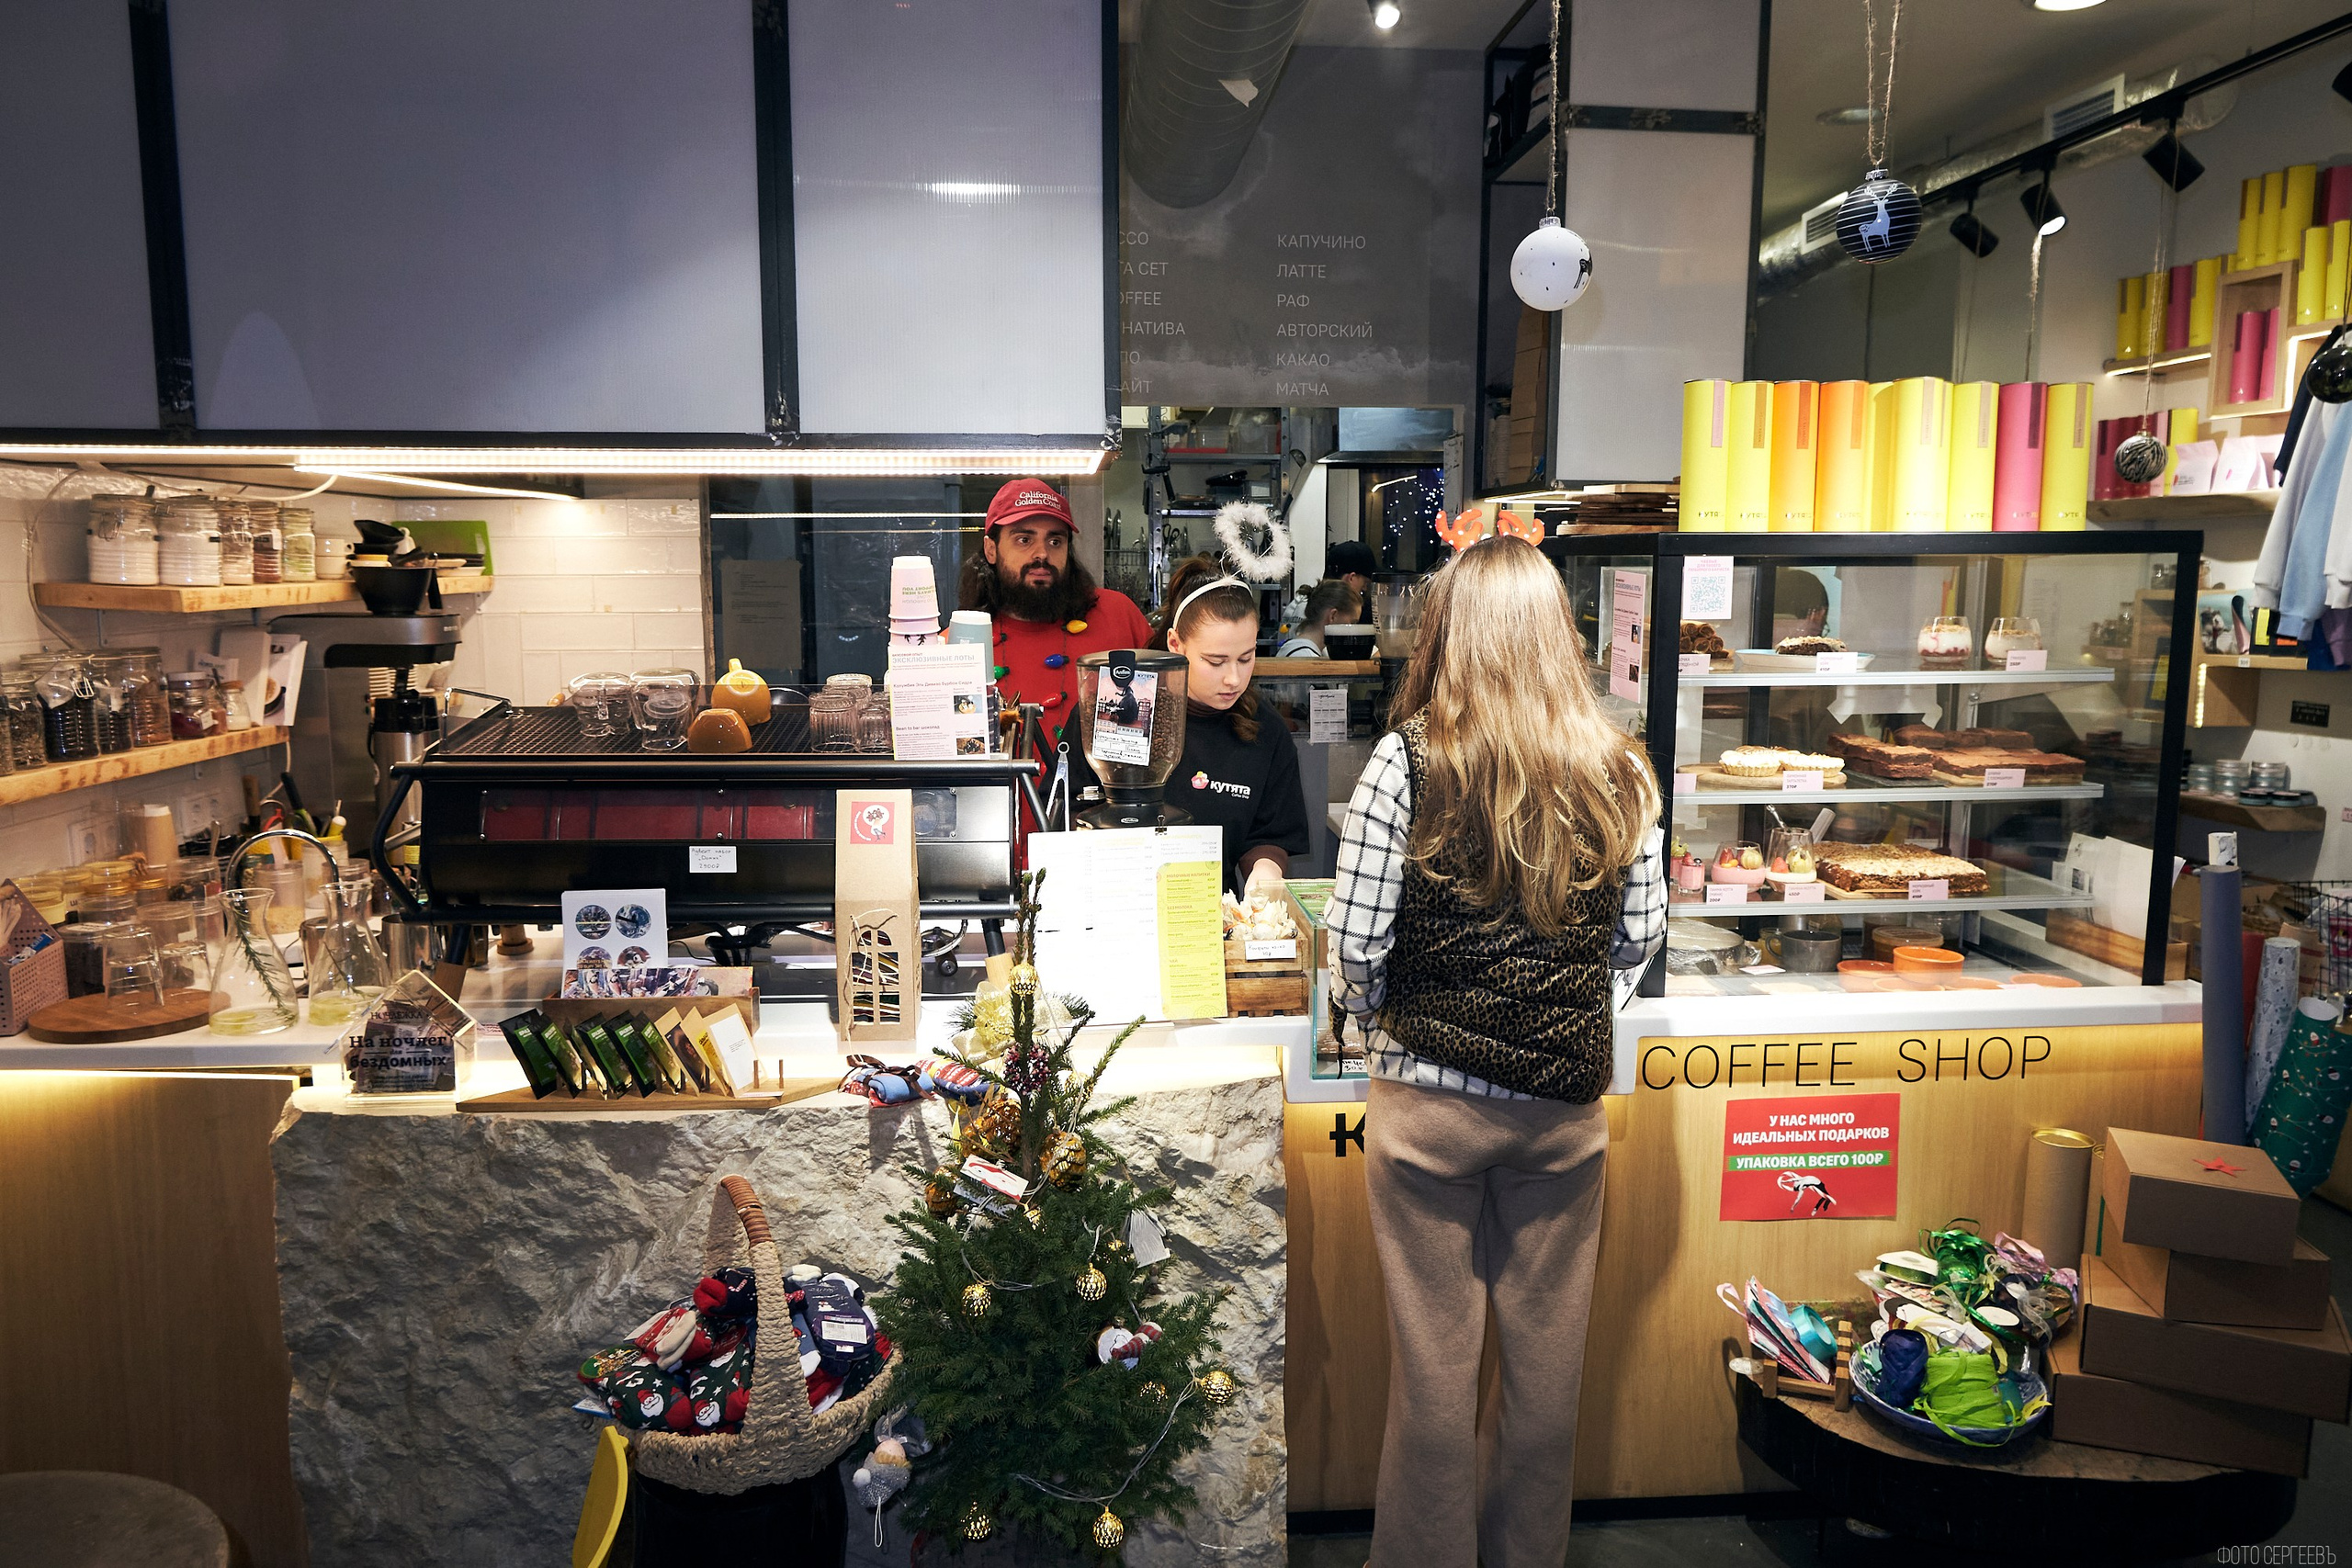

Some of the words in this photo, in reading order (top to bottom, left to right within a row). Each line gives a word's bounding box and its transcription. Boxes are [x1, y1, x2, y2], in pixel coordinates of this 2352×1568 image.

[1277, 234, 1366, 249] КАПУЧИНО
[1138, 262, 1169, 276] СЕТ
[1276, 264, 1327, 278] ЛАТТЕ
[1277, 294, 1310, 308] РАФ
[1276, 321, 1373, 338] АВТОРСКИЙ
[1276, 353, 1330, 367] КАКАО
[1276, 382, 1329, 396] МАТЧА
[1019, 491, 1058, 502] California
[1014, 498, 1044, 507] Golden
[1043, 498, 1062, 512] Coast
[370, 1011, 424, 1020] НОЧЛЕЖКА
[349, 1035, 375, 1048] На
[379, 1035, 447, 1048] ночлег
[349, 1055, 447, 1070] бездомных
[1642, 1042, 1859, 1090] COFFEE
[1896, 1035, 2052, 1084] SHOP
[1770, 1115, 1778, 1127] У
[1780, 1114, 1807, 1127] НАС
[1809, 1112, 1855, 1126] МНОГО
[1733, 1130, 1816, 1145] ИДЕАЛЬНЫХ
[1818, 1127, 1890, 1143] ПОДАРКОВ
[1736, 1156, 1806, 1169] УПАКОВКА
[1808, 1154, 1849, 1168] ВСЕГО
[1851, 1153, 1883, 1165] 100₽
